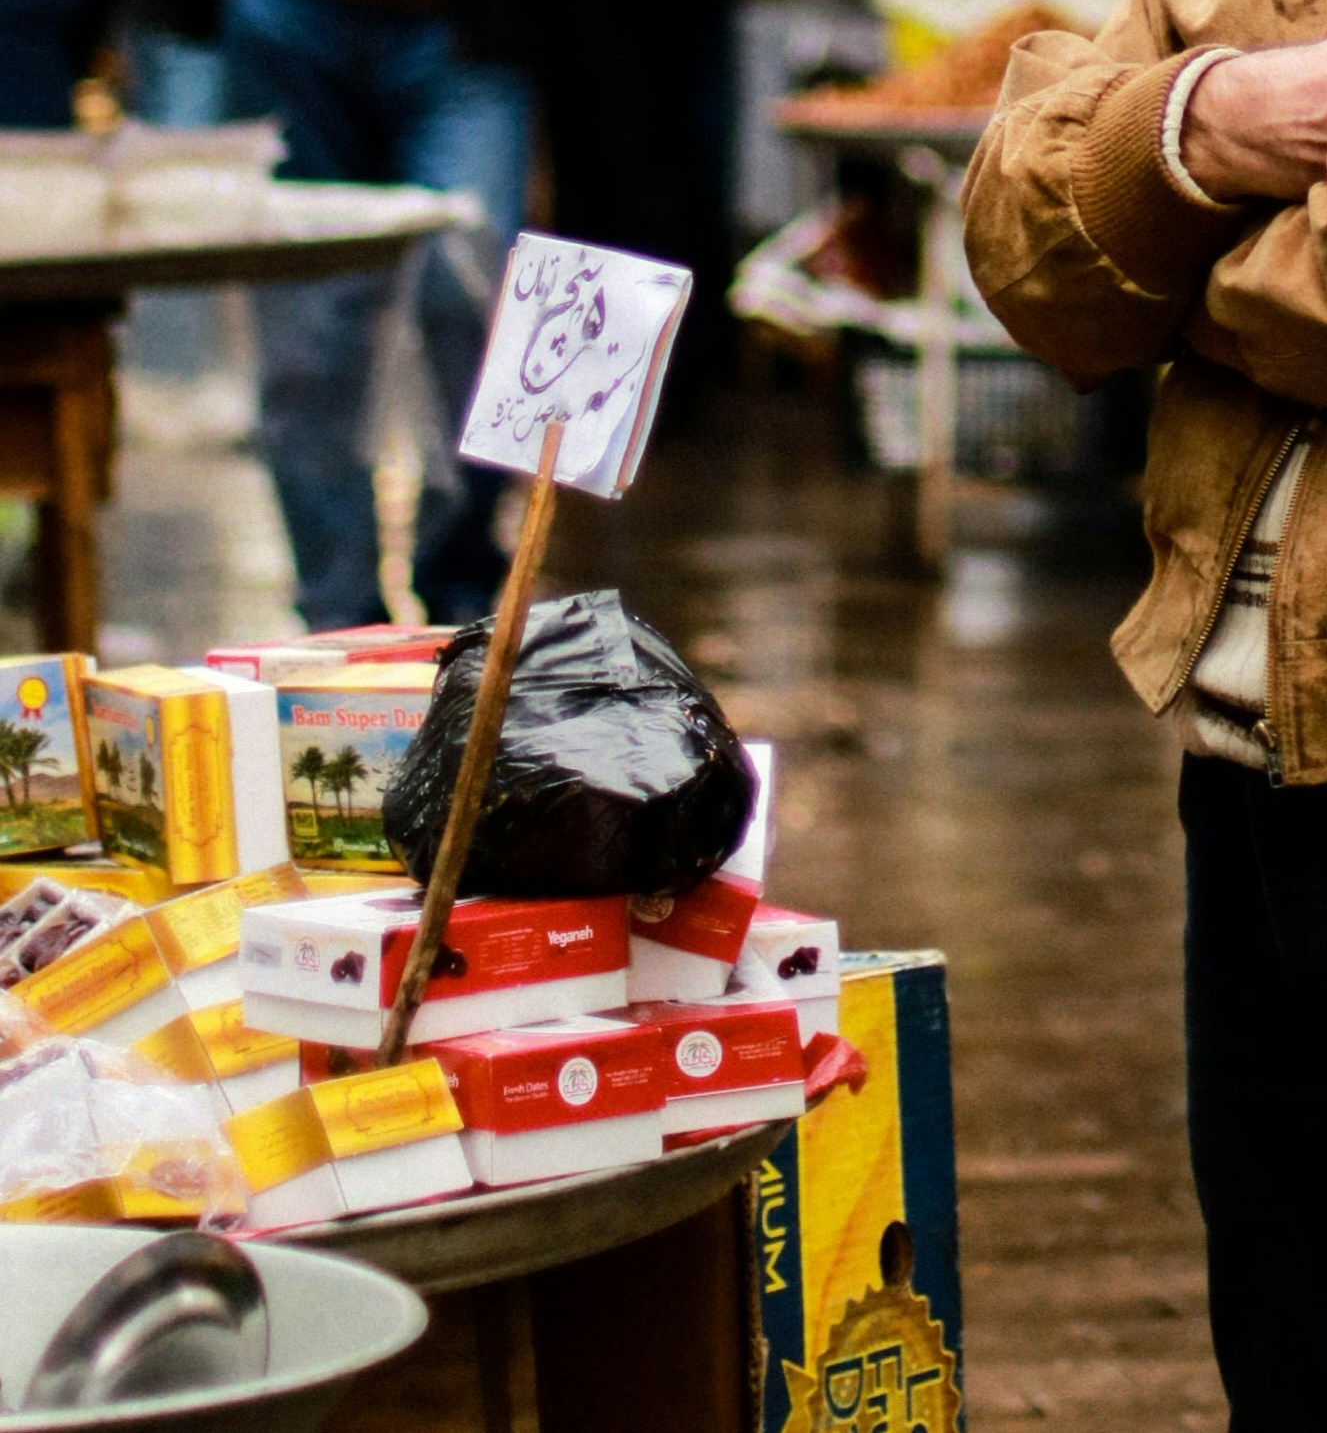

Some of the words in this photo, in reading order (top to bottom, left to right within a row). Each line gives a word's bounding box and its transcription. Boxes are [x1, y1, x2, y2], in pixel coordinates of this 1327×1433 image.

[293, 706, 331, 727] Bam
[335, 708, 388, 731] Super
[393, 708, 426, 729] Dat
[547, 925, 594, 948] Yeganeh
